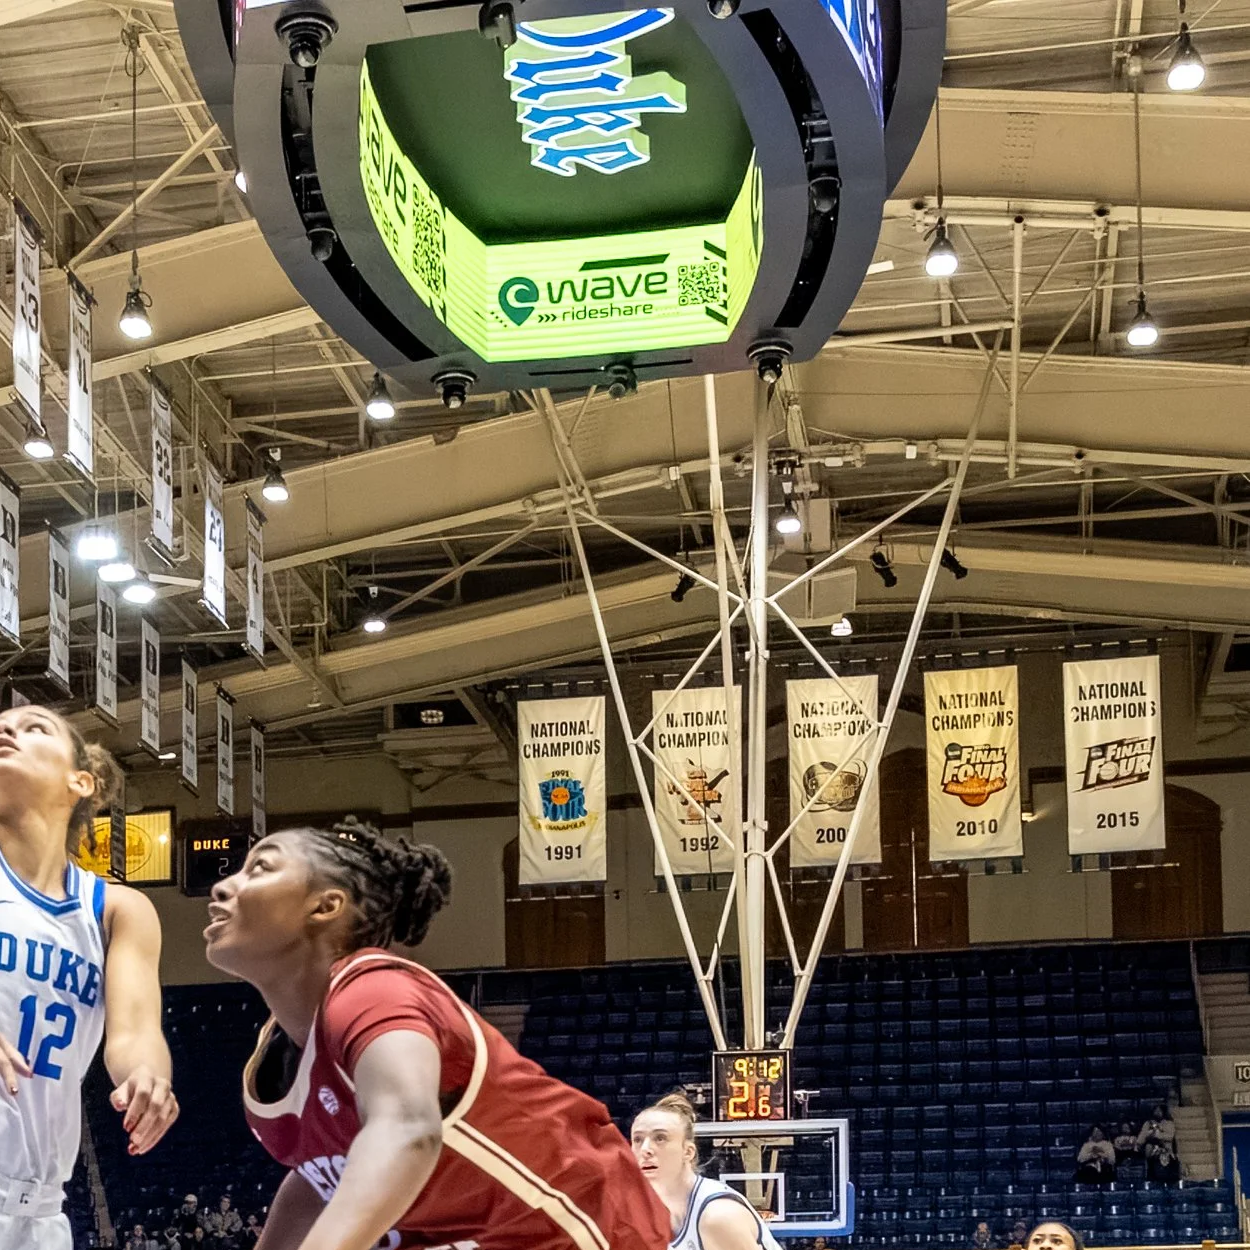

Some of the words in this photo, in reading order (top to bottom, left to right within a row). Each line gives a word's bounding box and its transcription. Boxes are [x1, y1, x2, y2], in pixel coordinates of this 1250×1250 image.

[547, 271, 668, 304] wave
[562, 303, 654, 322] rideshare
[938, 690, 1006, 711] NATIONAL
[1078, 680, 1147, 701] NATIONAL
[665, 709, 728, 729] NATIONAL
[800, 700, 864, 719] NATIONAL
[1070, 700, 1156, 723] CHAMPIONS
[530, 719, 594, 739] NATIONAL
[932, 710, 1014, 732] CHAMPIONS
[523, 738, 601, 759] CHAMPIONS
[960, 744, 1007, 764] FINAL
[1105, 737, 1153, 761] FINAL
[551, 769, 569, 778] 1991
[944, 761, 1007, 786] FOUR
[1088, 753, 1152, 786] FOUR
[956, 818, 998, 837] 2010
[1096, 811, 1140, 829] 2015
[193, 838, 231, 852] DUKE
[680, 835, 719, 853] 1992
[815, 827, 850, 844] 200
[544, 844, 583, 862] 1991
[18, 994, 77, 1081] 12
[734, 1057, 781, 1079] 9:12
[728, 1081, 772, 1118] 2.6
